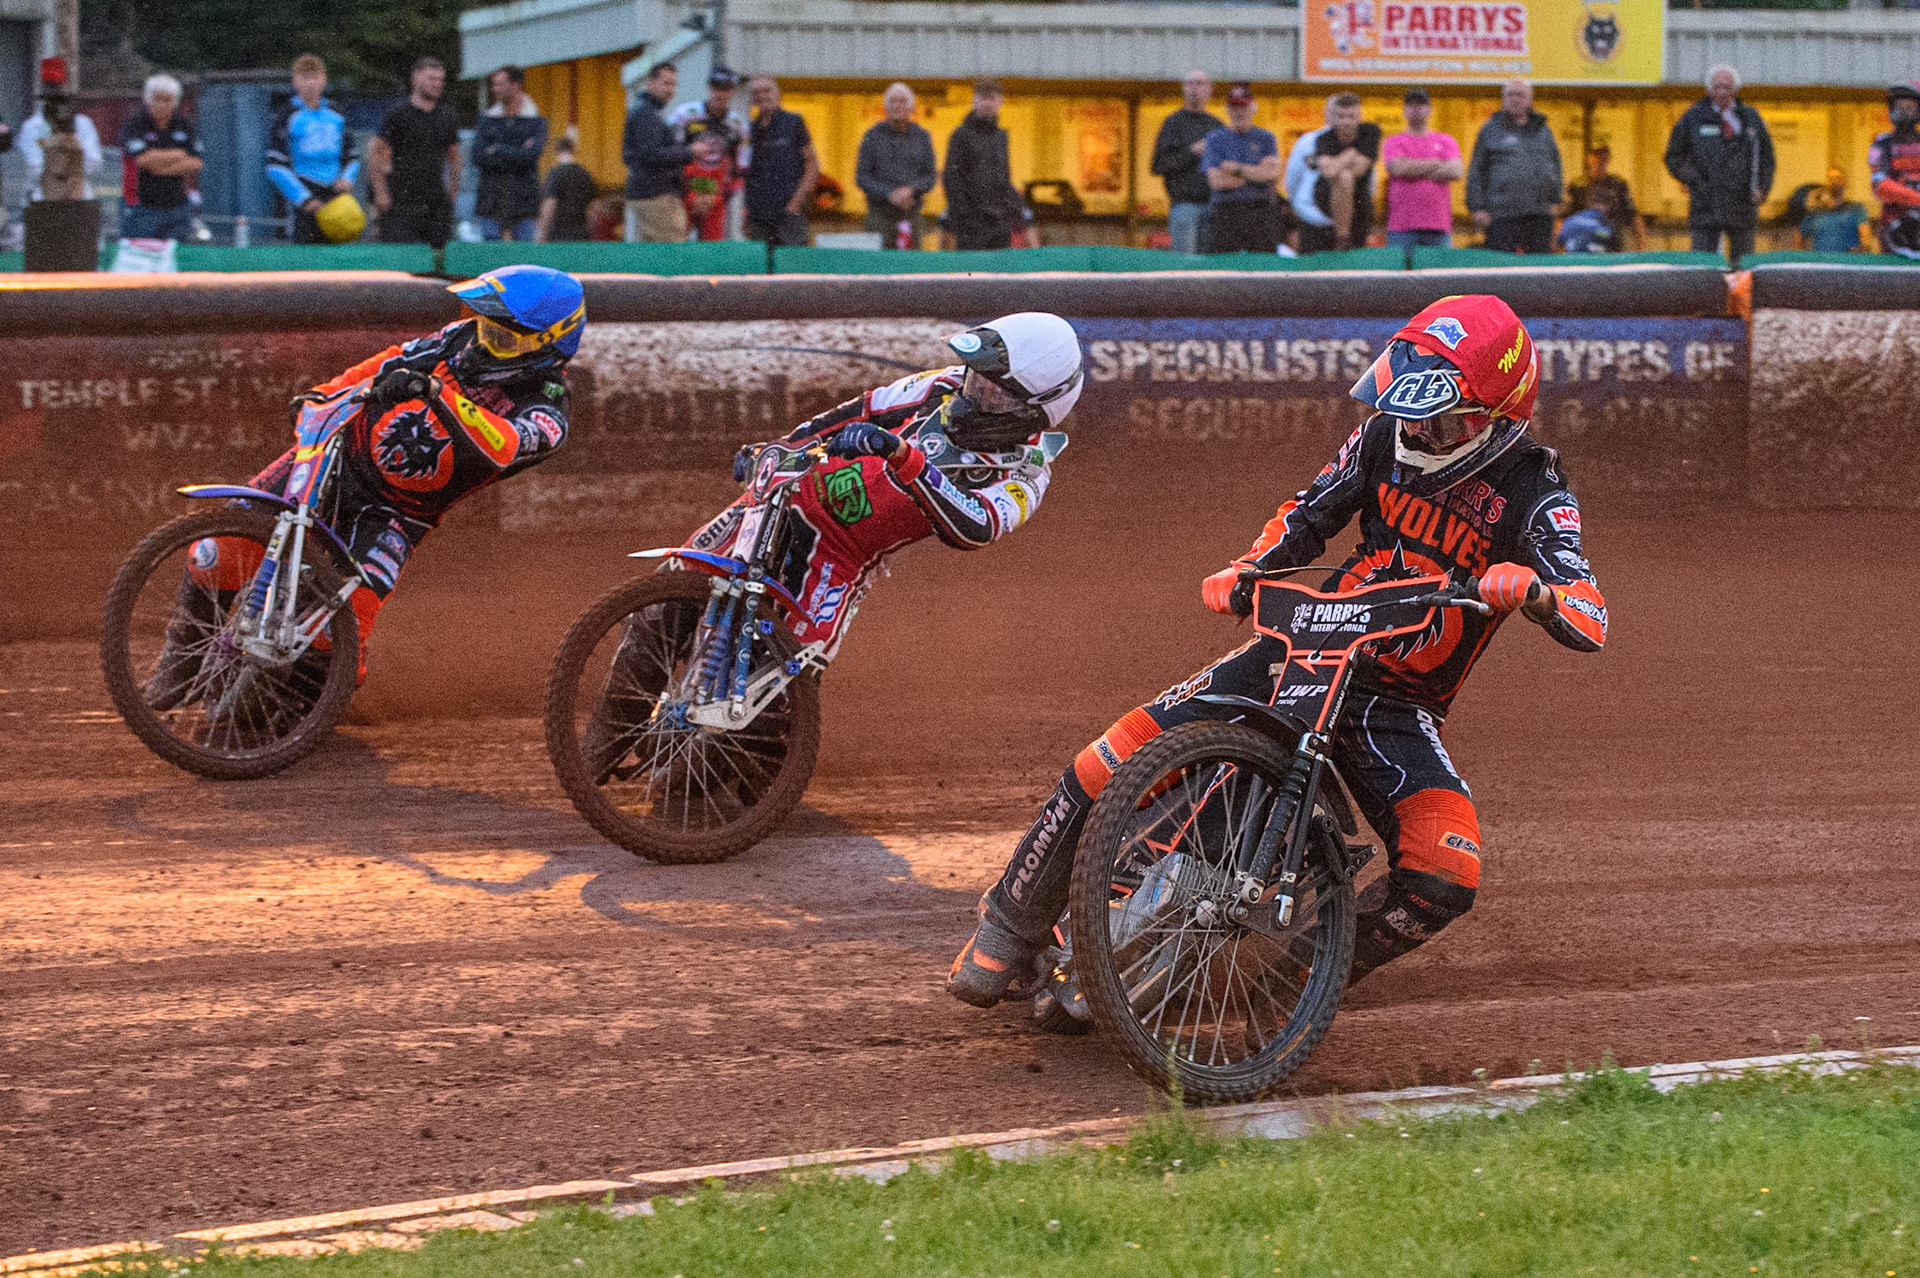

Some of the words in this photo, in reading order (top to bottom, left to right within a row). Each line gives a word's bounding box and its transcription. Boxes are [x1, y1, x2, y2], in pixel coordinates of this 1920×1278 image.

[1384, 5, 1525, 33] PARRYS
[1383, 36, 1525, 52] INTERNATIONAL
[1090, 339, 1372, 382] SPECIALISTS
[1536, 340, 1673, 382] TYPES
[17, 379, 160, 408] TEMPLE
[1552, 508, 1581, 524] NG
[1377, 482, 1492, 578] WOLVES
[1312, 603, 1371, 623] PARRYS
[1276, 698, 1298, 706] racing
[1278, 685, 1329, 697] JWP
